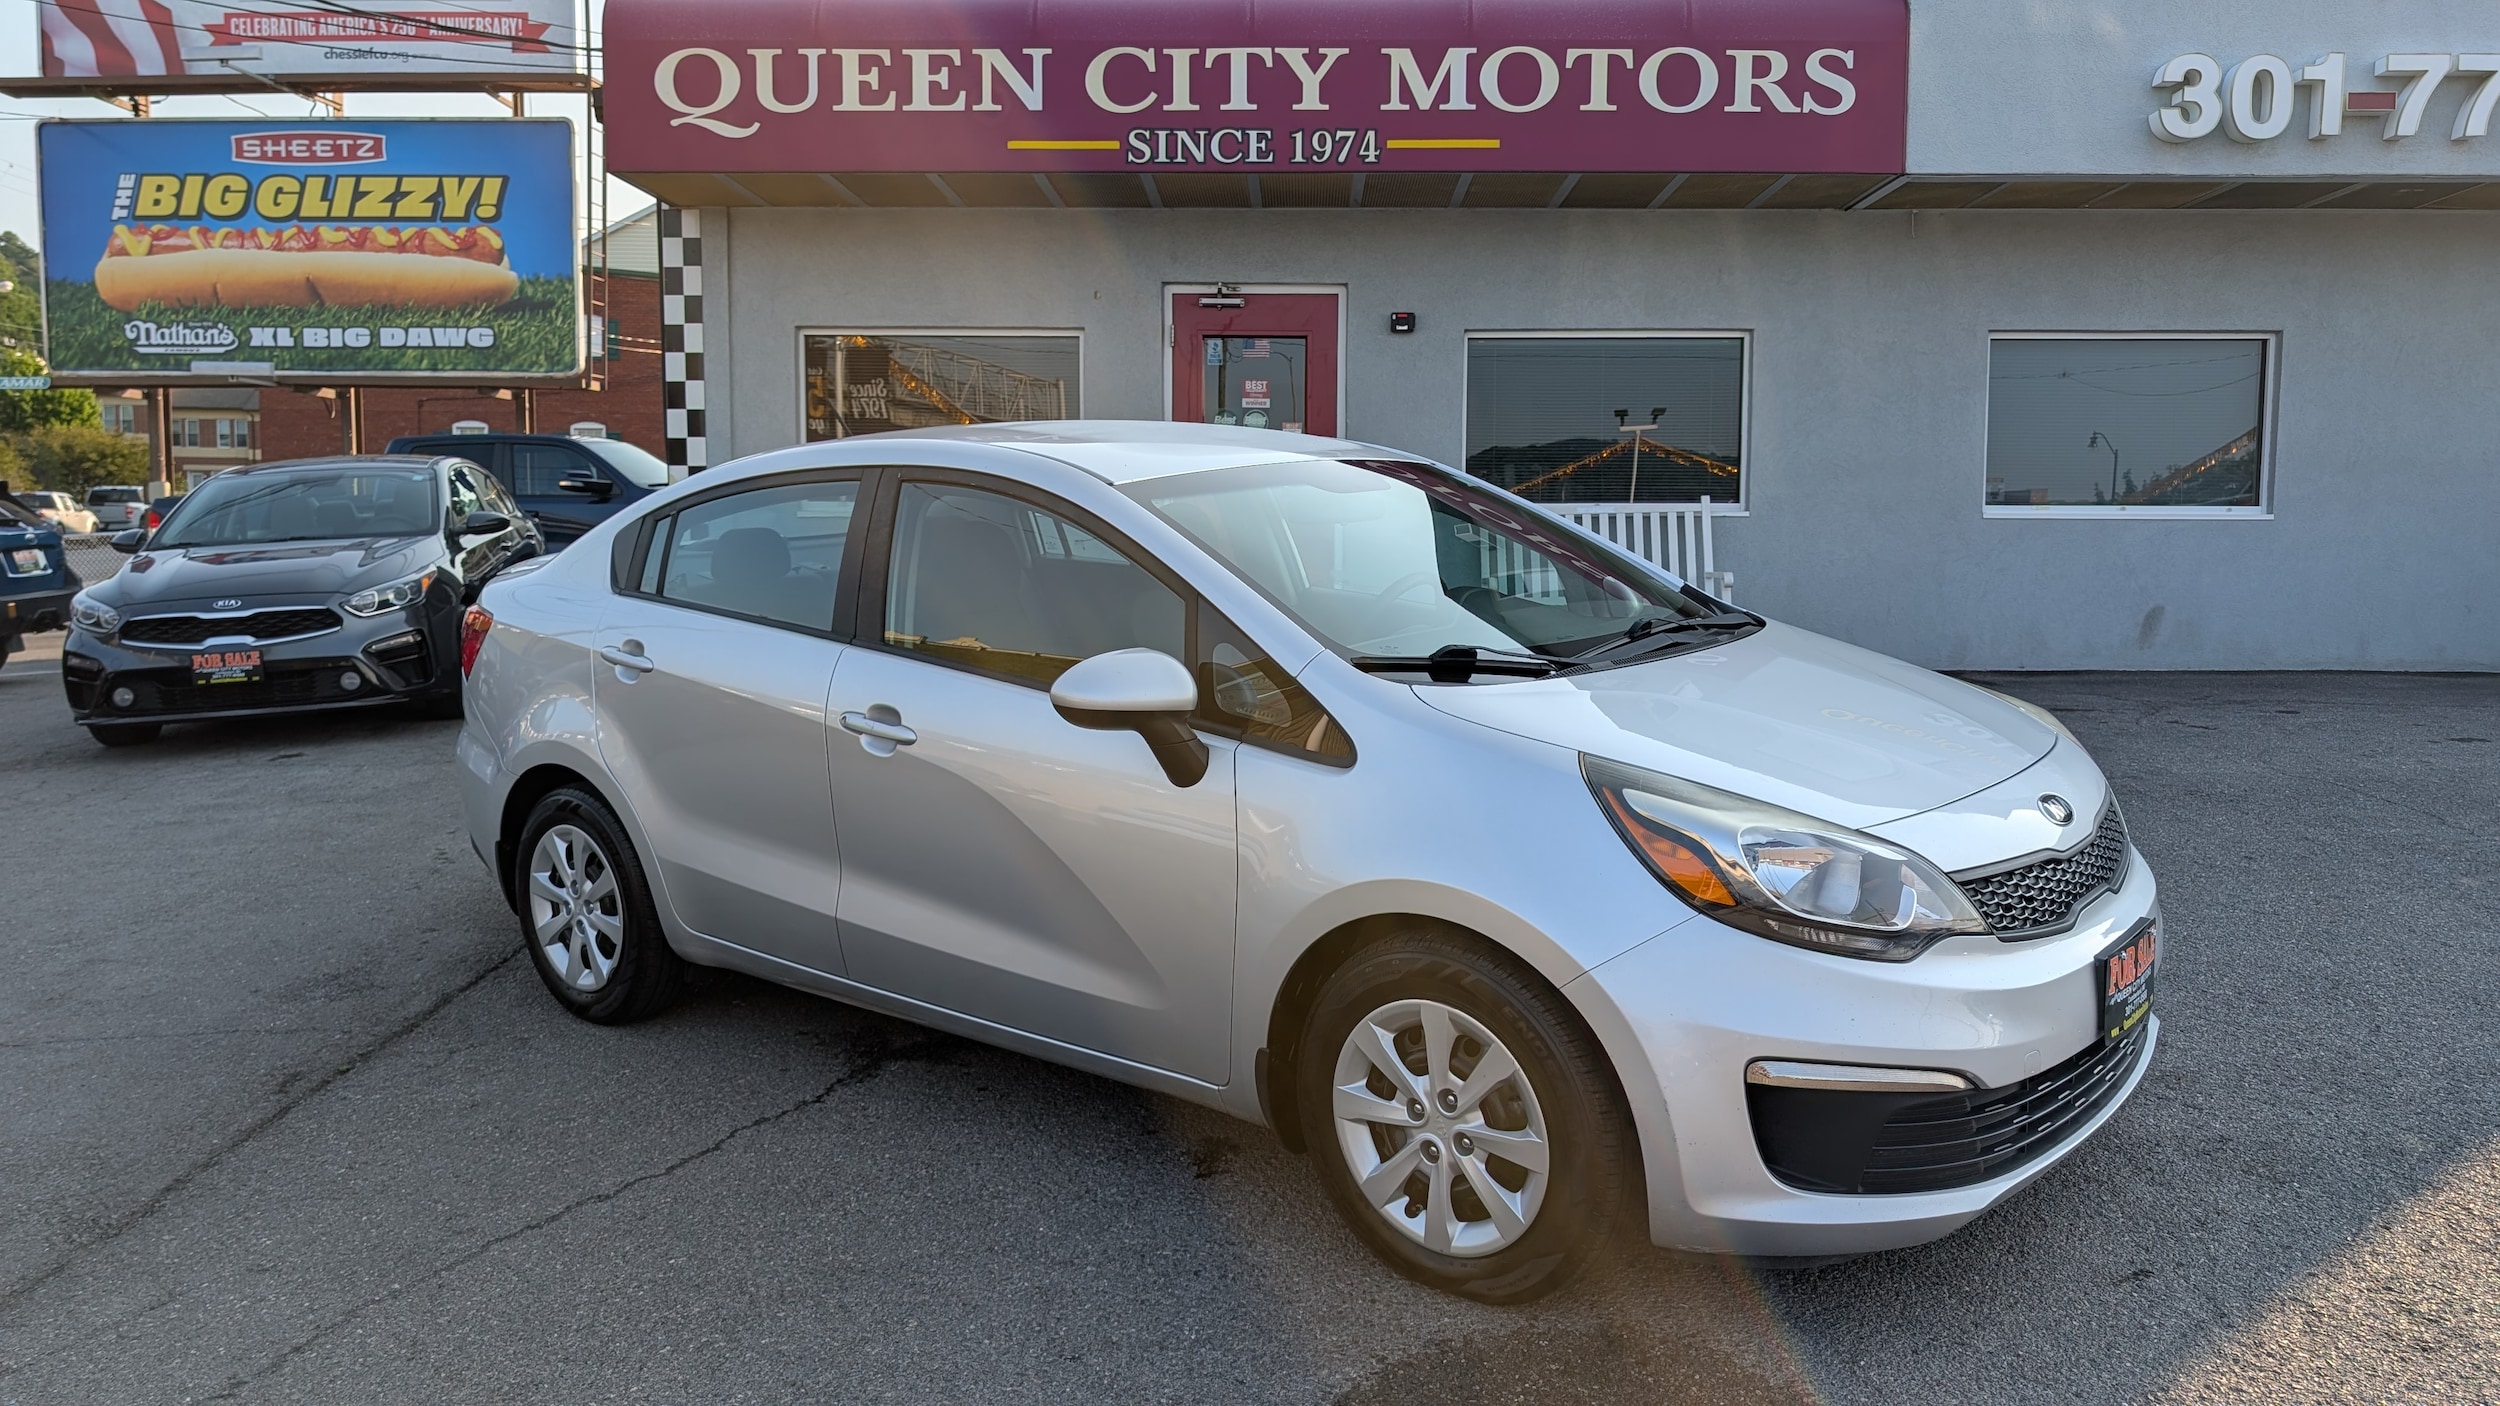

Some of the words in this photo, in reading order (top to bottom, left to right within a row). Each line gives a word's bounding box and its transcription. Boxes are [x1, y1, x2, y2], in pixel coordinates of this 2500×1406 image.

[230, 16, 317, 37] CELEBRATING
[318, 16, 389, 36] AMERICA'S
[429, 16, 524, 37] ANNIVERSARY!
[653, 46, 1053, 139] QUEEN
[1084, 46, 1350, 114] CITY
[1379, 45, 1857, 116] MOTORS
[242, 139, 375, 158] SHEETZ
[1126, 128, 1274, 164] SINCE
[1289, 128, 1381, 164] 1974
[111, 173, 137, 221] THE
[133, 173, 250, 221] BIG
[255, 174, 507, 221] GLIZZY!
[124, 320, 236, 346] Nathan's
[249, 327, 295, 347] XL
[302, 327, 372, 348] BIG
[379, 327, 495, 348] DAWG
[1245, 380, 1268, 389] BEST
[217, 599, 236, 607] KIA
[192, 653, 223, 669] FOR
[225, 651, 260, 667] SALE
[2109, 945, 2136, 996] FOR
[2137, 924, 2156, 977] SALE
